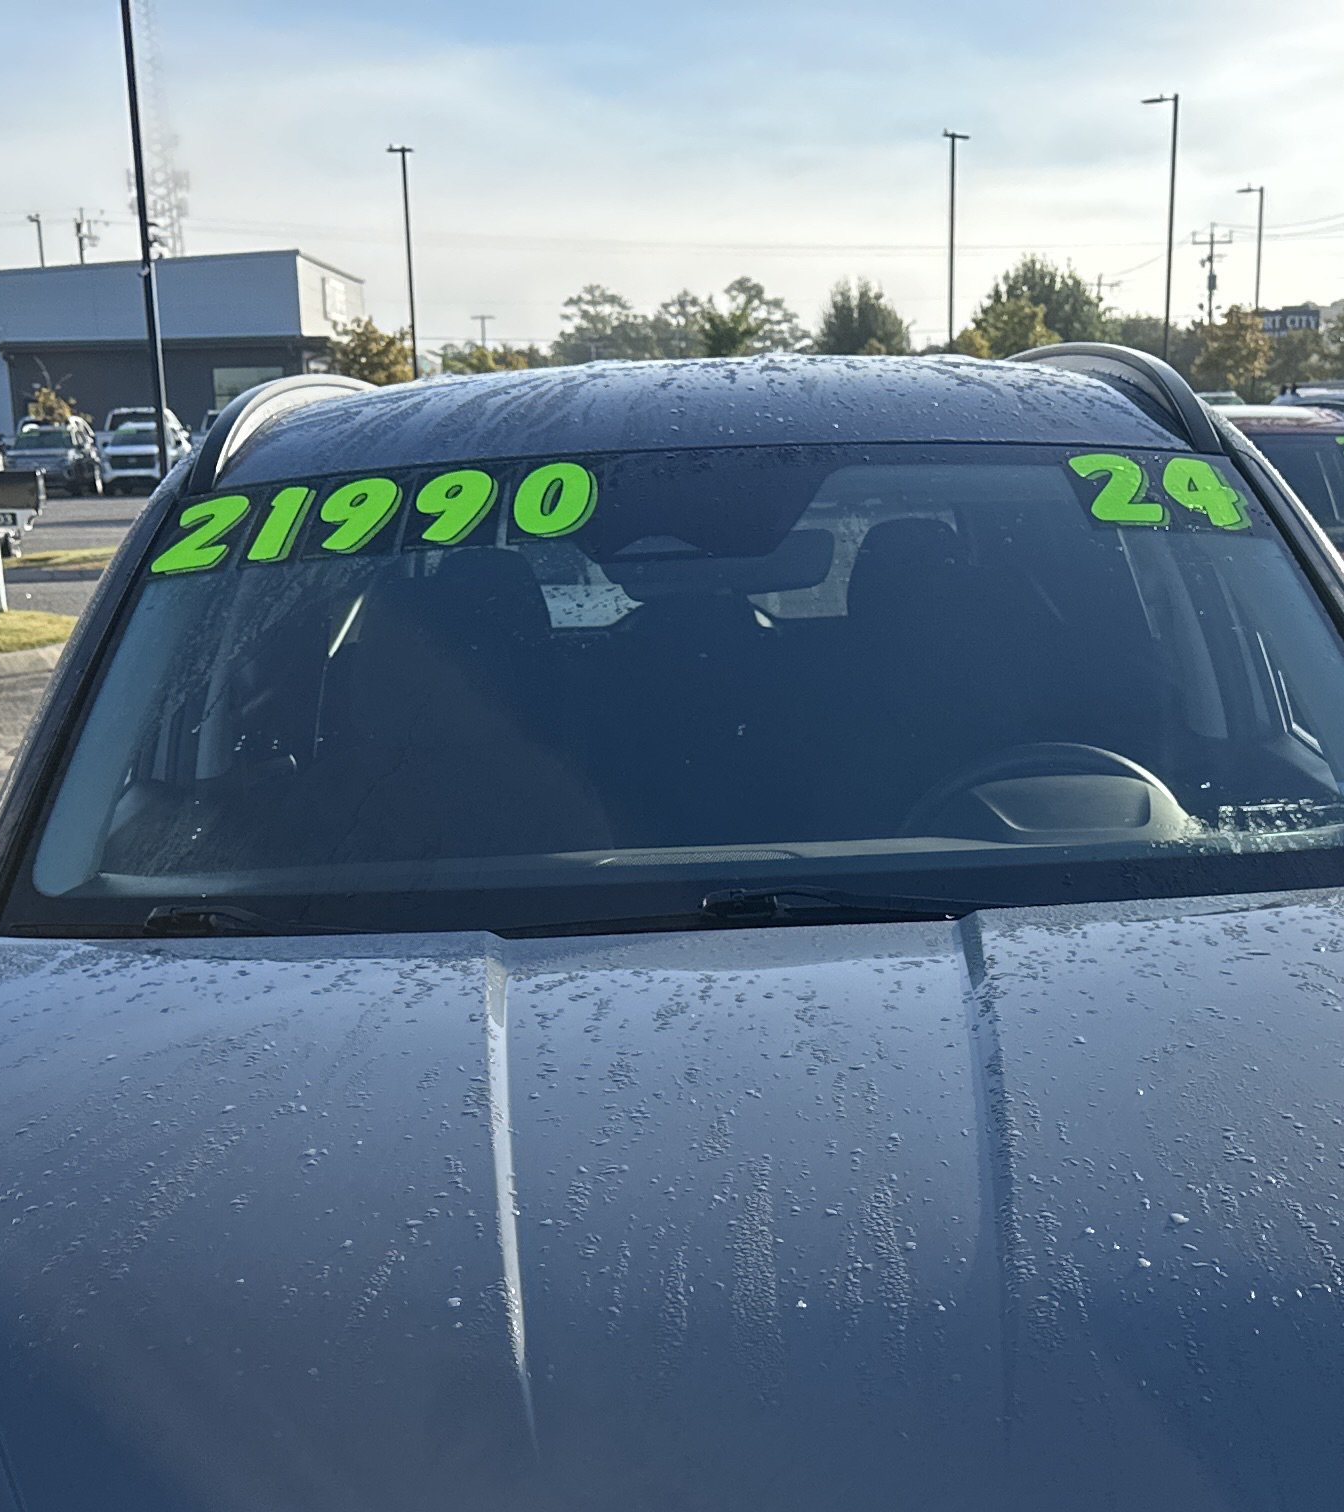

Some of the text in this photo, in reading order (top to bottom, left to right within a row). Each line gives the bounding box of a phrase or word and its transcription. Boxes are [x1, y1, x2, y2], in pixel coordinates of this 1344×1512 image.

[1285, 315, 1317, 330] CITY
[151, 462, 598, 576] 21990
[1068, 453, 1253, 531] 24
